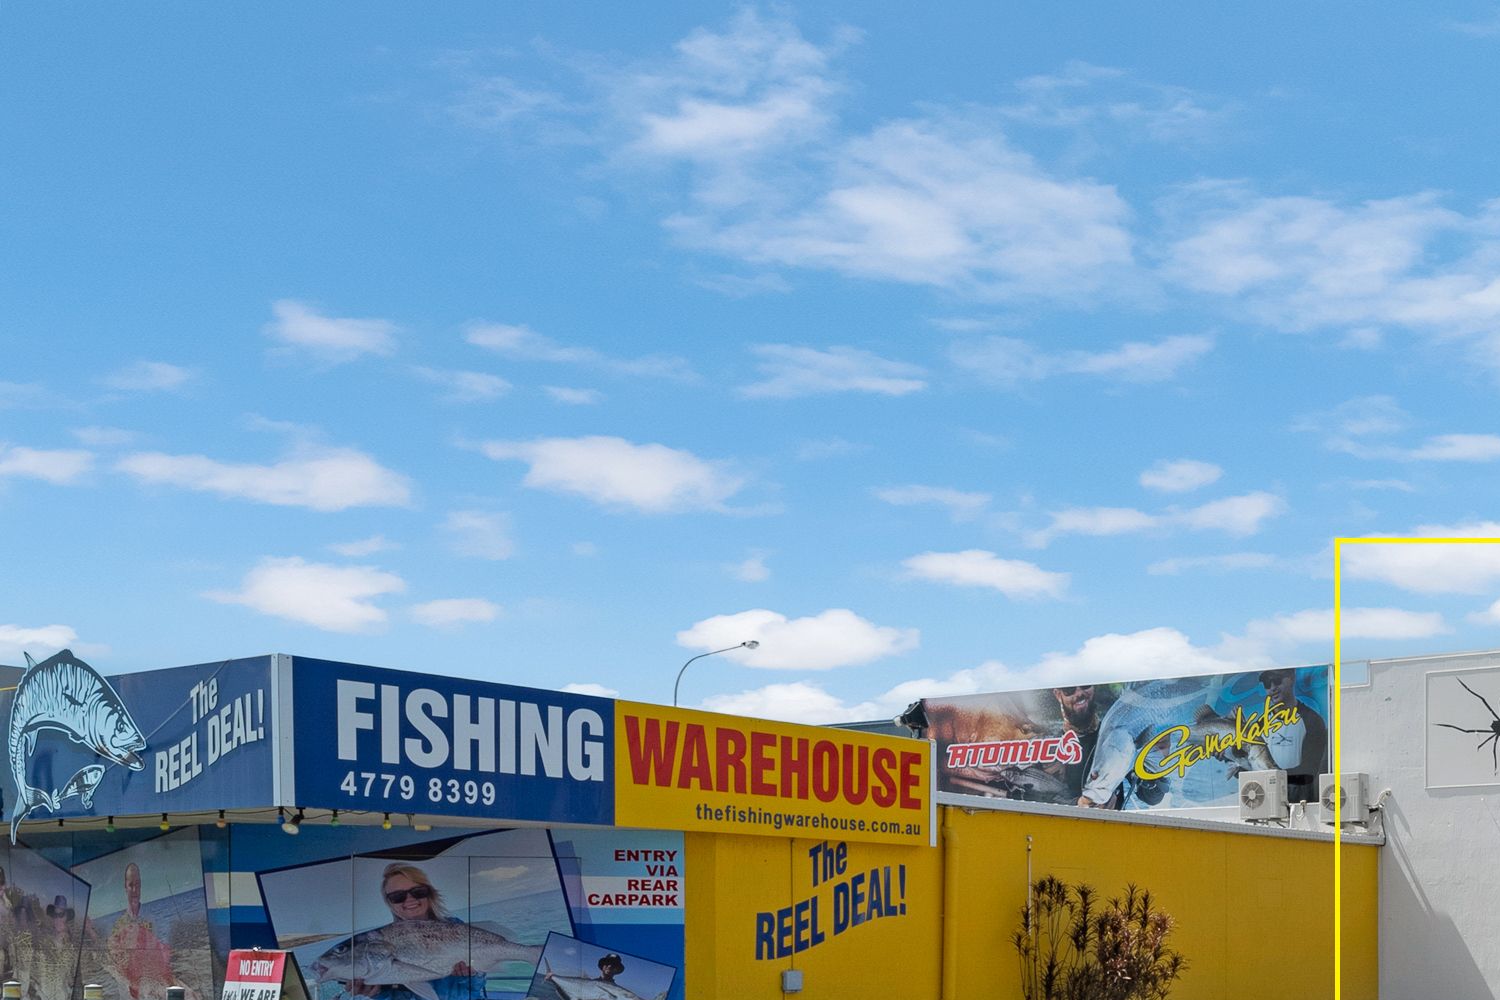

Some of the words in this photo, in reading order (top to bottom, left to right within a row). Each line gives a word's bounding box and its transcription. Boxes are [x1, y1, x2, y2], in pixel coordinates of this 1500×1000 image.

[190, 677, 218, 725] The
[155, 731, 203, 793] REEL
[207, 689, 264, 767] DEAL!
[337, 679, 604, 782] FISHING
[624, 715, 922, 810] WAREHOUSE
[946, 731, 1083, 769] ATOMIC
[340, 771, 415, 801] 4779
[428, 777, 496, 806] 8399
[696, 803, 921, 836] thefishingwarehouse.com.au
[614, 849, 677, 862] ENTRY
[645, 864, 678, 877] VIA
[809, 840, 848, 888] The
[588, 893, 678, 906] CARPARK
[627, 879, 678, 892] REAR
[755, 895, 825, 961] REEL
[833, 864, 906, 936] DEAL!
[239, 960, 250, 976] NO
[251, 960, 275, 977] ENTRY
